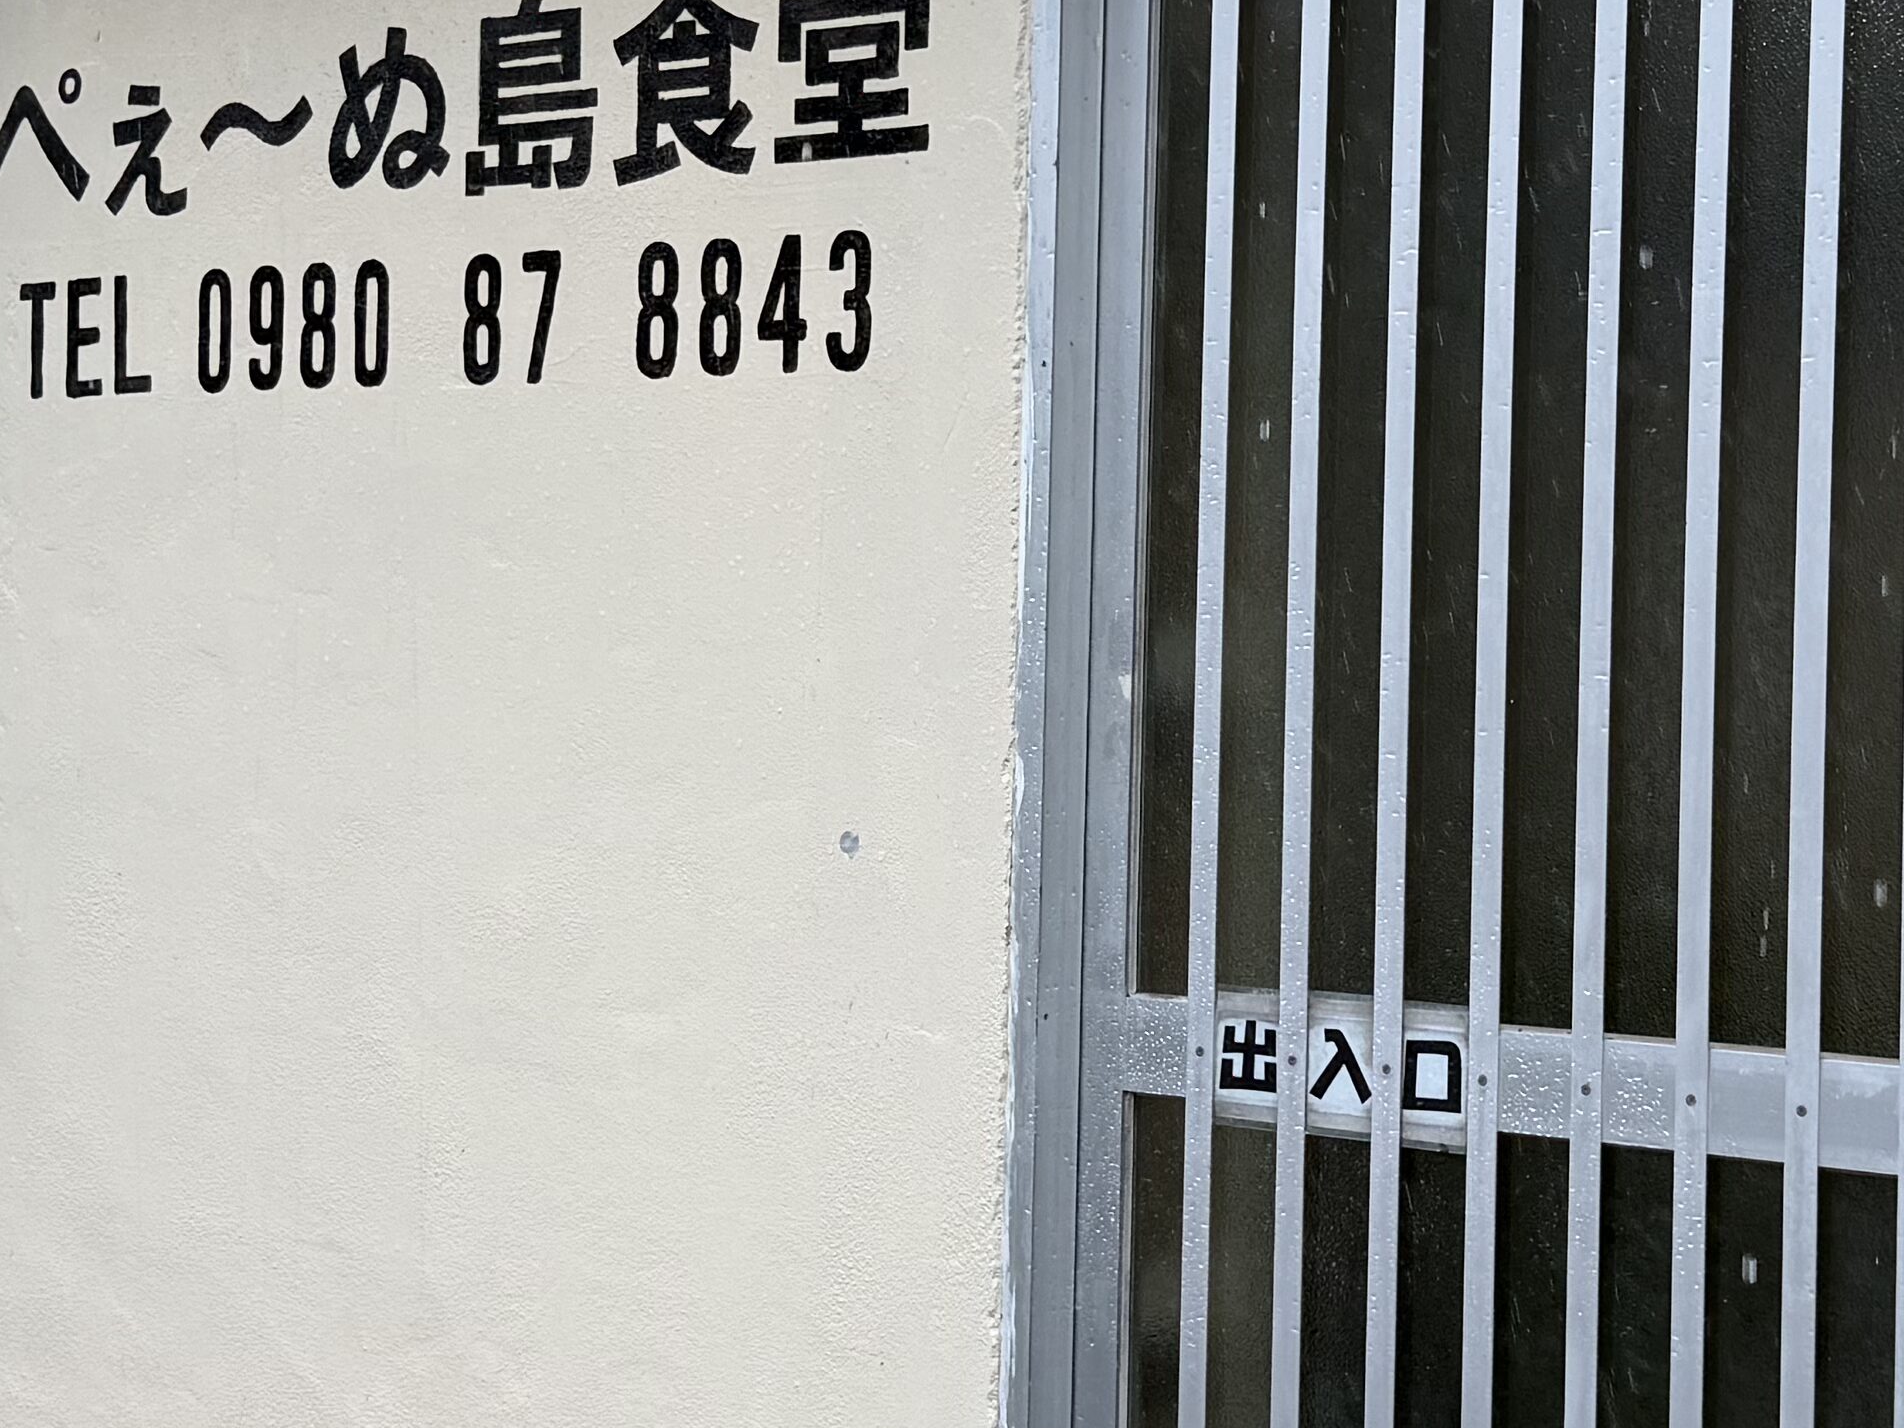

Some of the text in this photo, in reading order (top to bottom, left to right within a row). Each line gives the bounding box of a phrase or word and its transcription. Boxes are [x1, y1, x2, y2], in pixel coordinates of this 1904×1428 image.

[19, 230, 873, 398] TEL 0980 87 8843
[1219, 1020, 1461, 1113] 出入口
